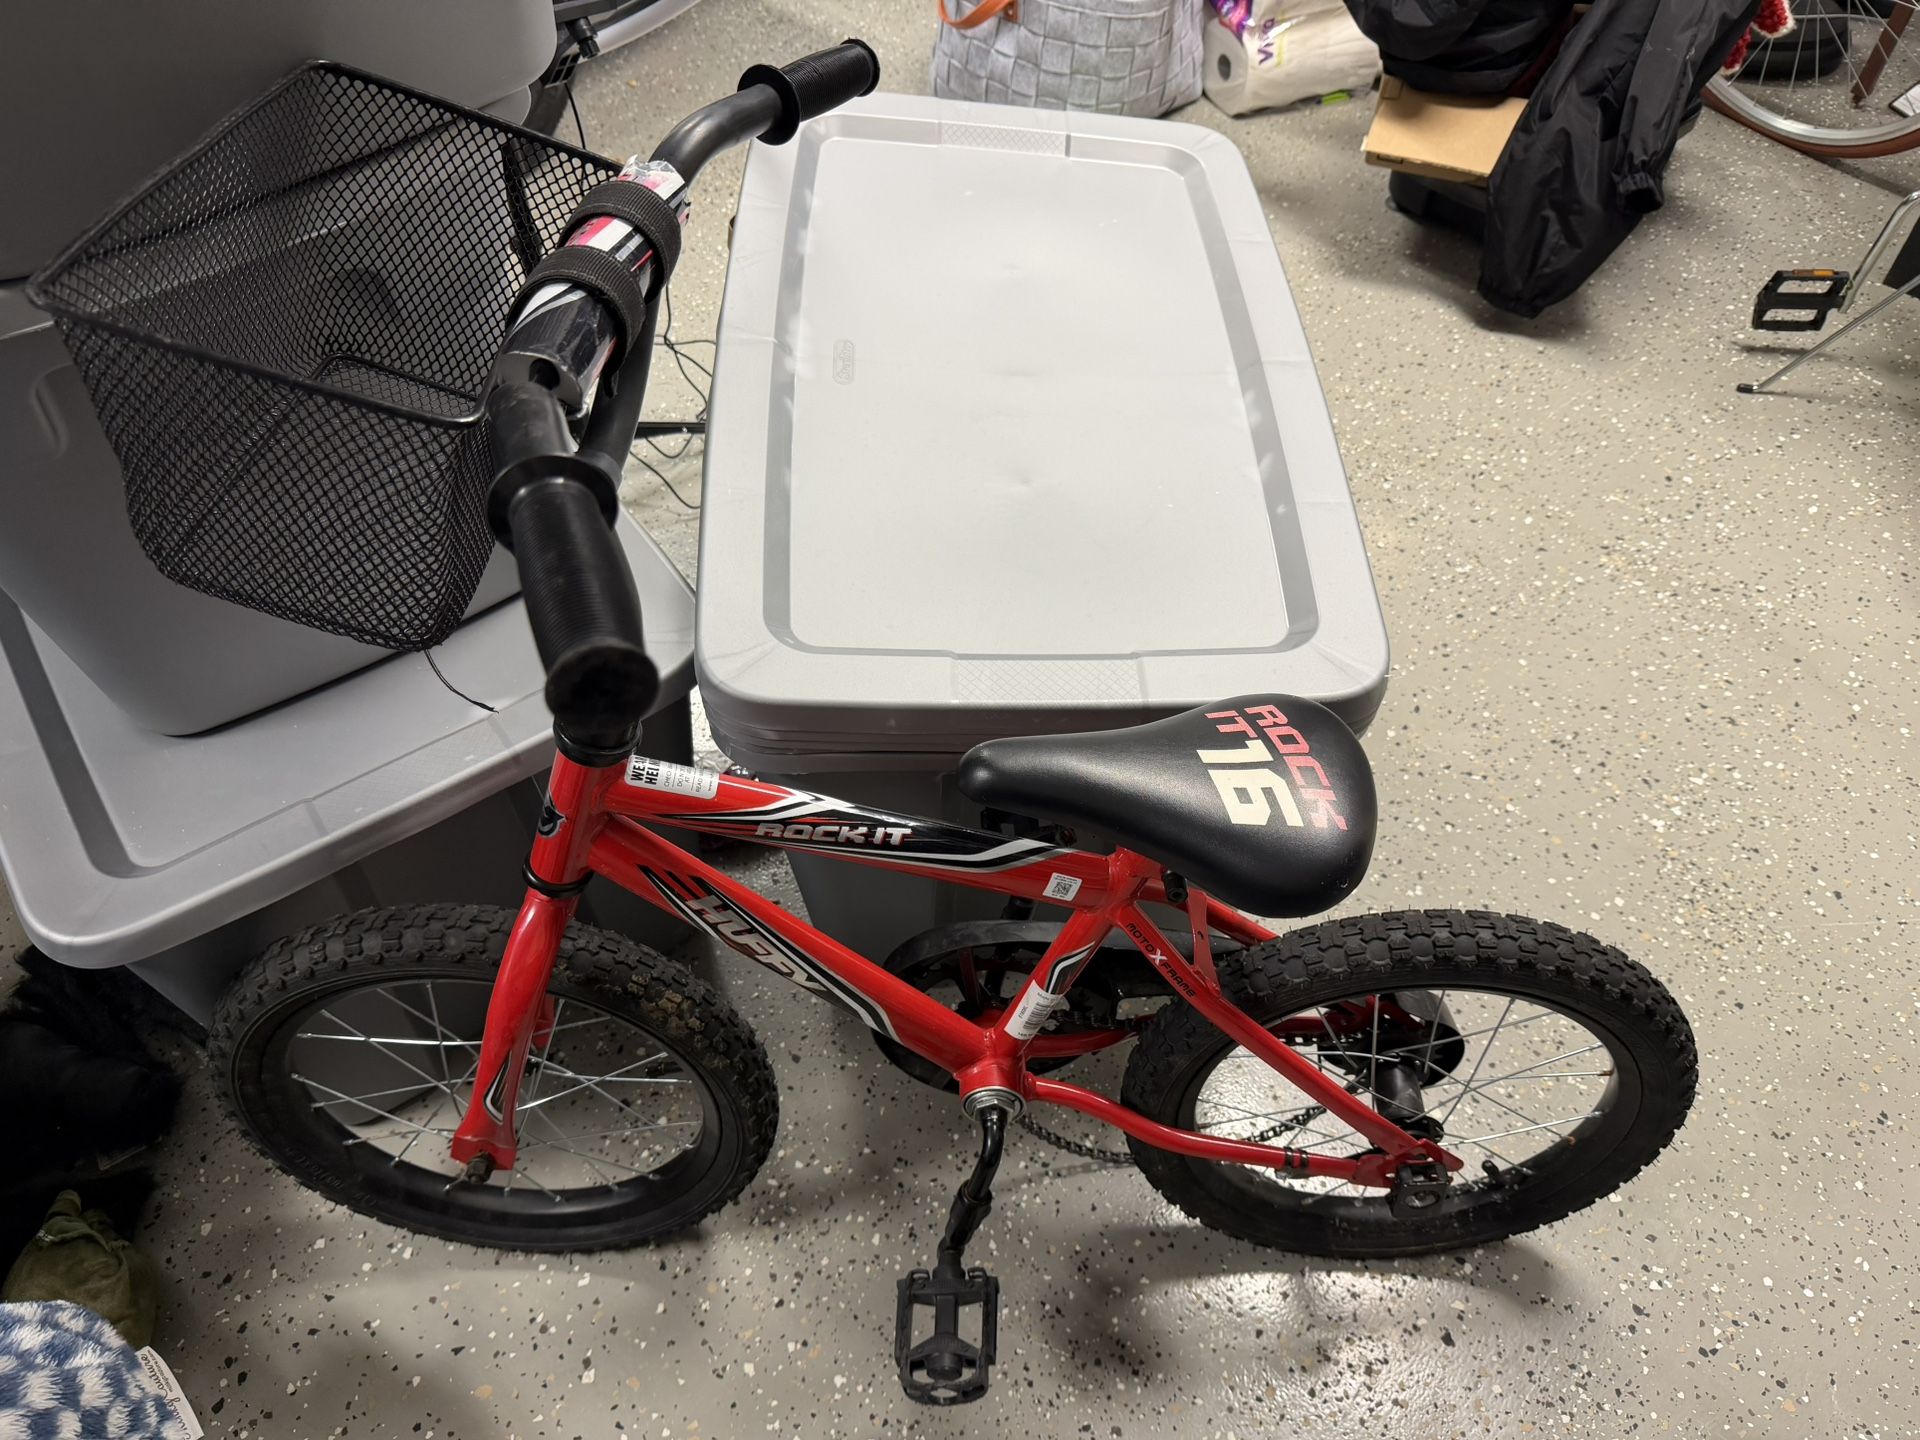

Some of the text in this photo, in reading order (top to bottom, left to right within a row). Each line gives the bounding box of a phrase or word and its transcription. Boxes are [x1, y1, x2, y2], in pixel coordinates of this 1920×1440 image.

[1204, 710, 1258, 738] IT
[1244, 704, 1348, 830] ROCK
[1196, 739, 1304, 827] 16
[686, 894, 828, 992] HUFFY
